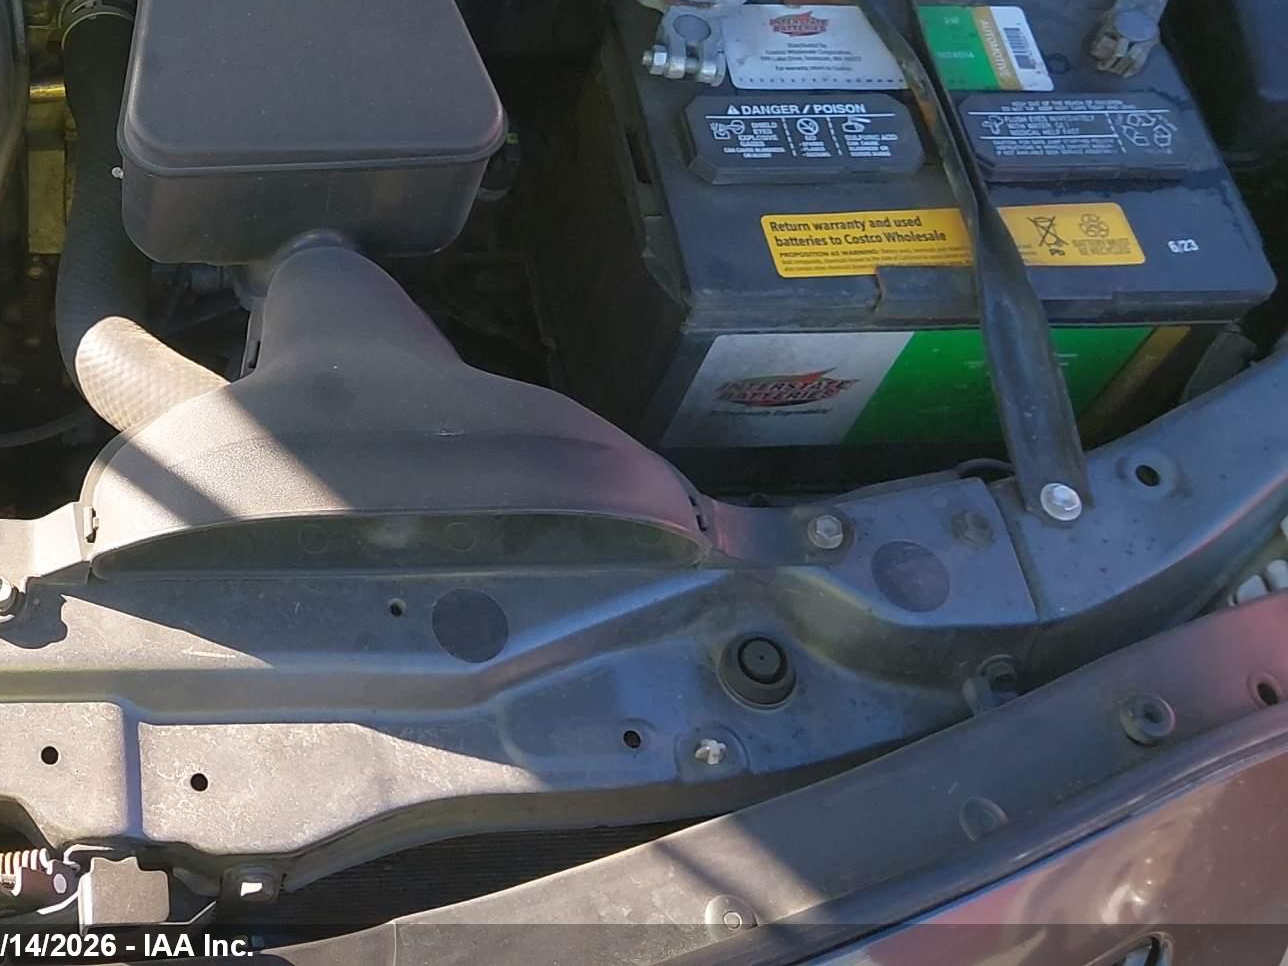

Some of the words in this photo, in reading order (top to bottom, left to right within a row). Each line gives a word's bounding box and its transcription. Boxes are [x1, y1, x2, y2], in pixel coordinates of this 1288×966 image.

[741, 104, 801, 115] DANGER
[813, 103, 867, 114] POISON
[769, 220, 810, 232] Return
[812, 219, 866, 232] warranty
[869, 217, 892, 228] and
[894, 216, 922, 227] used
[774, 234, 828, 247] batteries
[829, 235, 842, 245] to
[844, 233, 883, 245] Costco
[884, 230, 946, 243] Wholesale
[1168, 239, 1199, 253] 6/23
